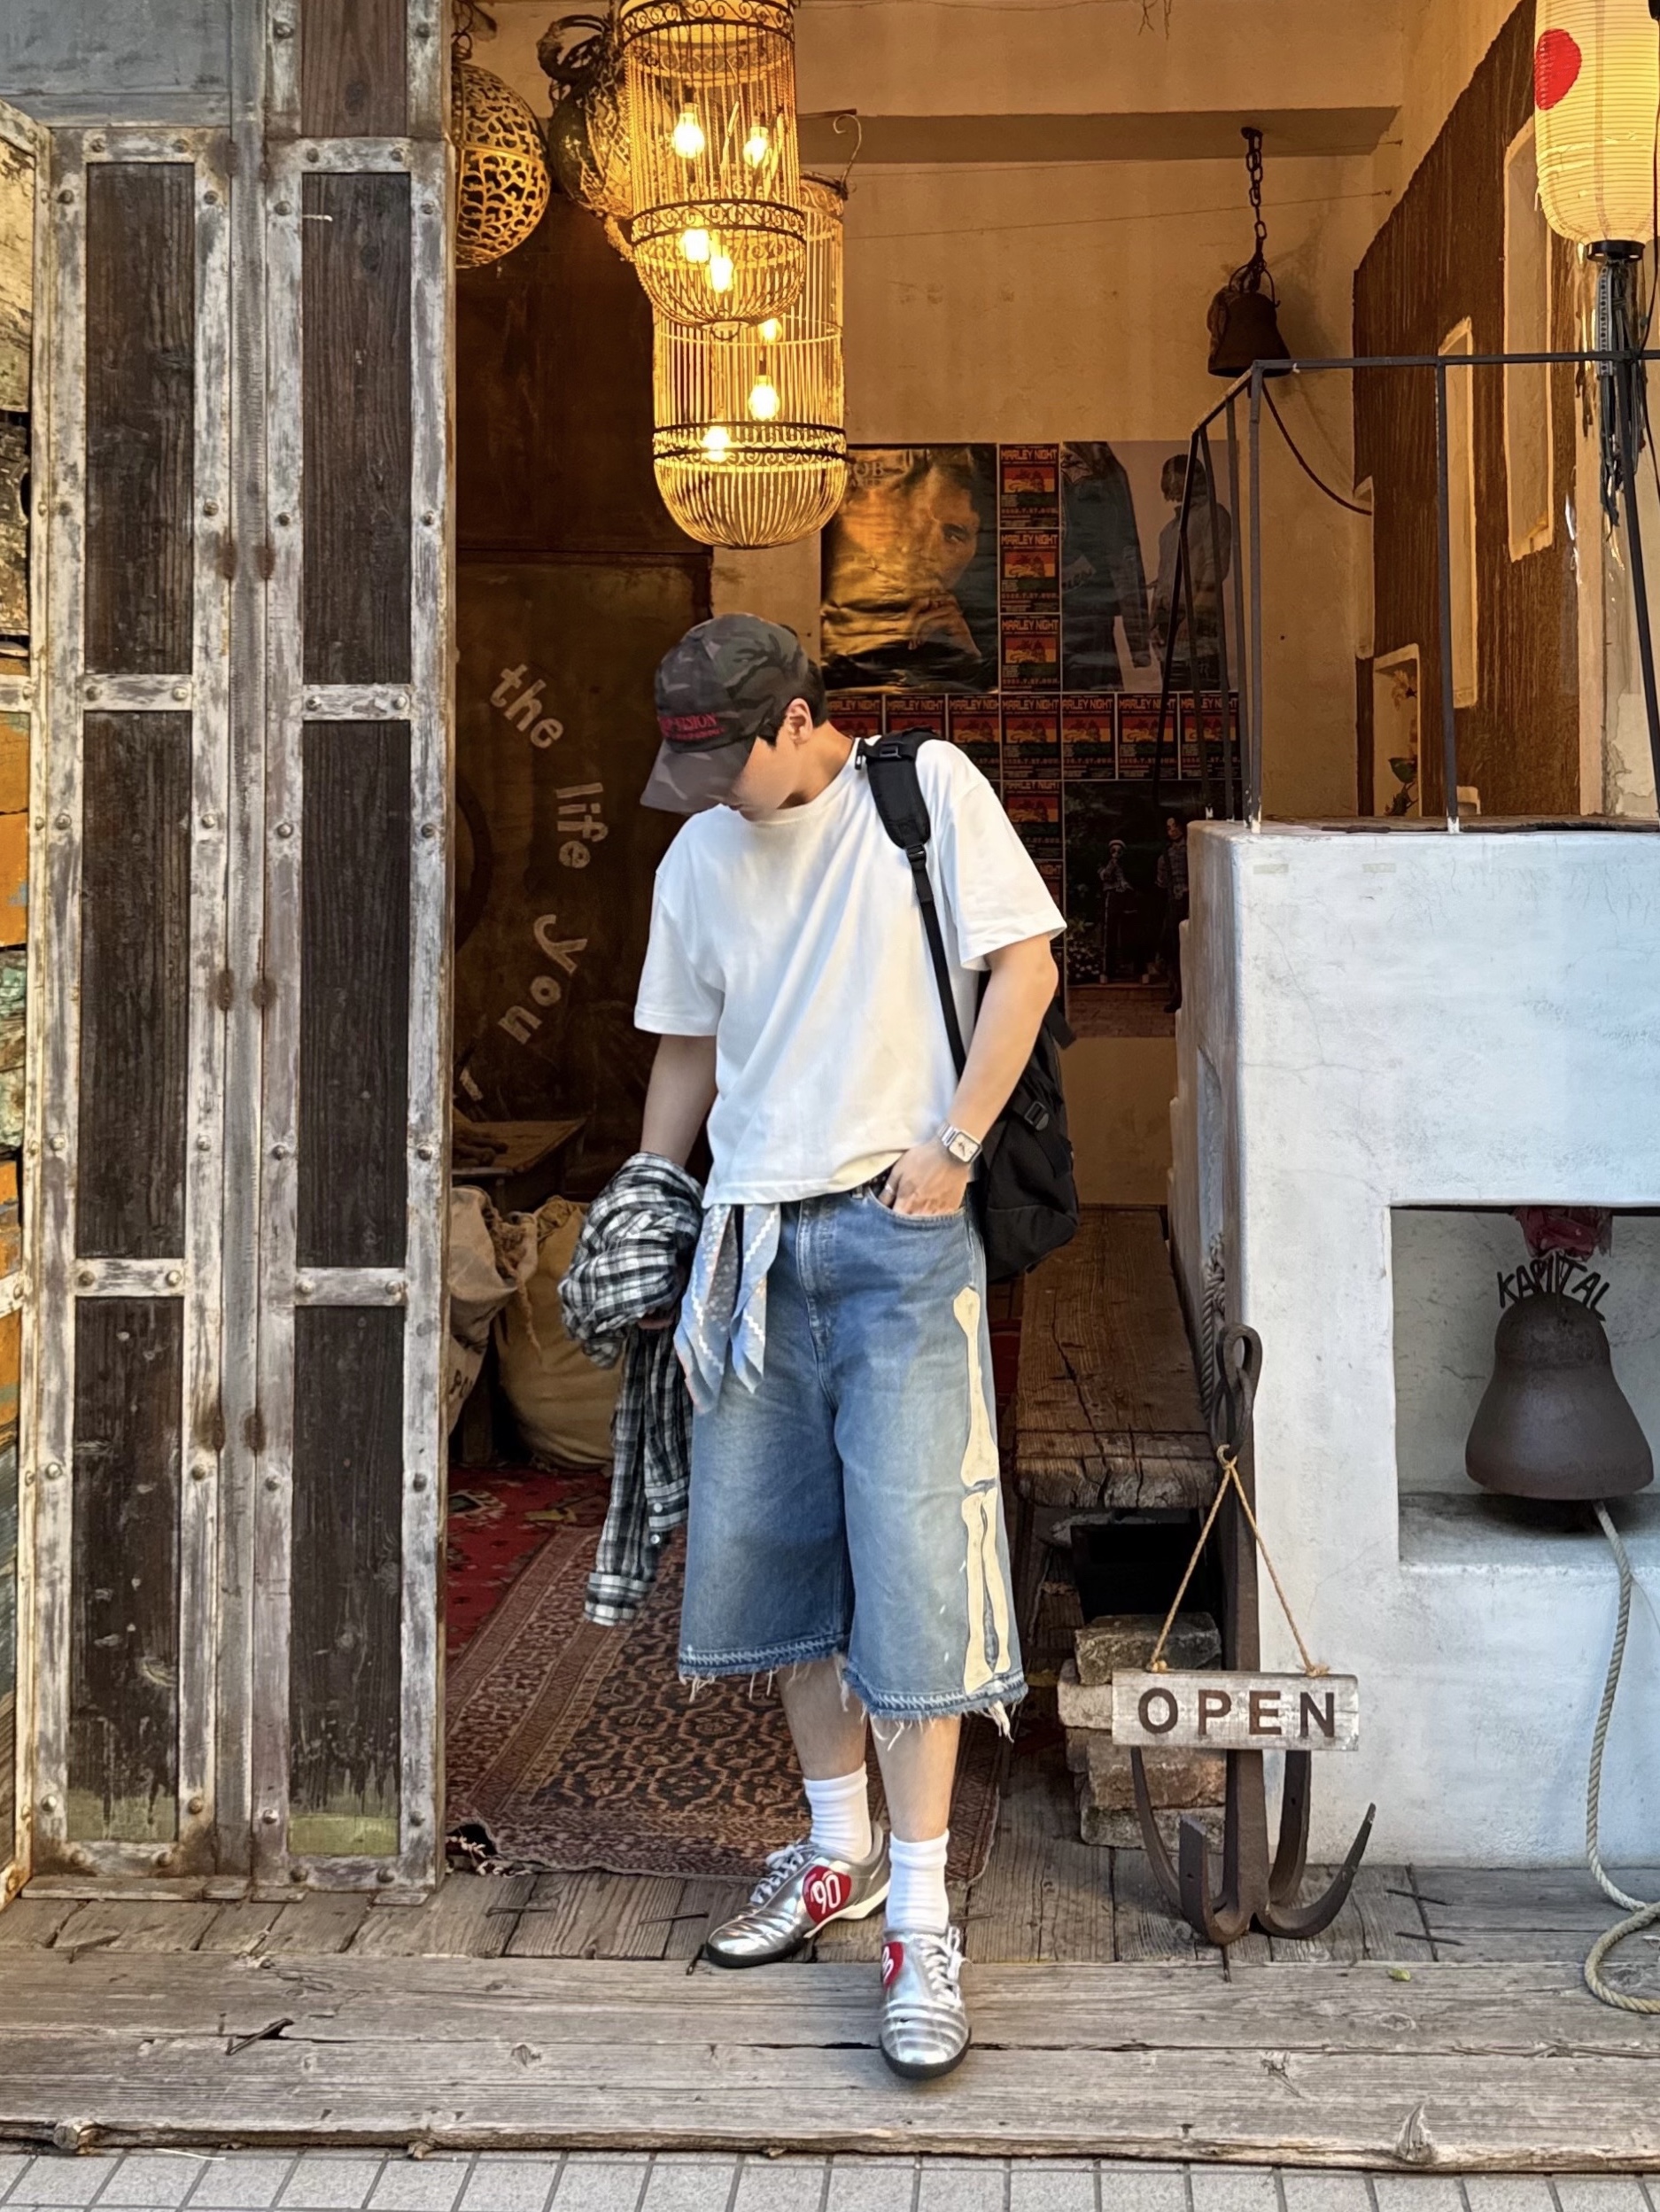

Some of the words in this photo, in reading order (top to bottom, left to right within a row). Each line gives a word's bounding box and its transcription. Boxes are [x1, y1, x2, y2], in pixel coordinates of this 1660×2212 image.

[1001, 449, 1034, 460] MARLEY
[1035, 449, 1058, 460] NIGHT
[1001, 534, 1035, 545] MARLEY
[1036, 534, 1059, 545] NIGHT
[1002, 619, 1035, 630] MARLEY
[1036, 619, 1059, 630] NIGHT
[489, 664, 564, 749] the
[950, 700, 981, 710] MARLEY
[983, 699, 999, 710] NIGH
[1002, 699, 1035, 710] MARLEY
[1062, 699, 1089, 709] ARLEY
[1119, 698, 1152, 709] MARLEY
[555, 782, 609, 869] life
[498, 913, 588, 1044] you
[1497, 1252, 1610, 1322] KAPITAL
[1137, 1688, 1335, 1738] OPEN
